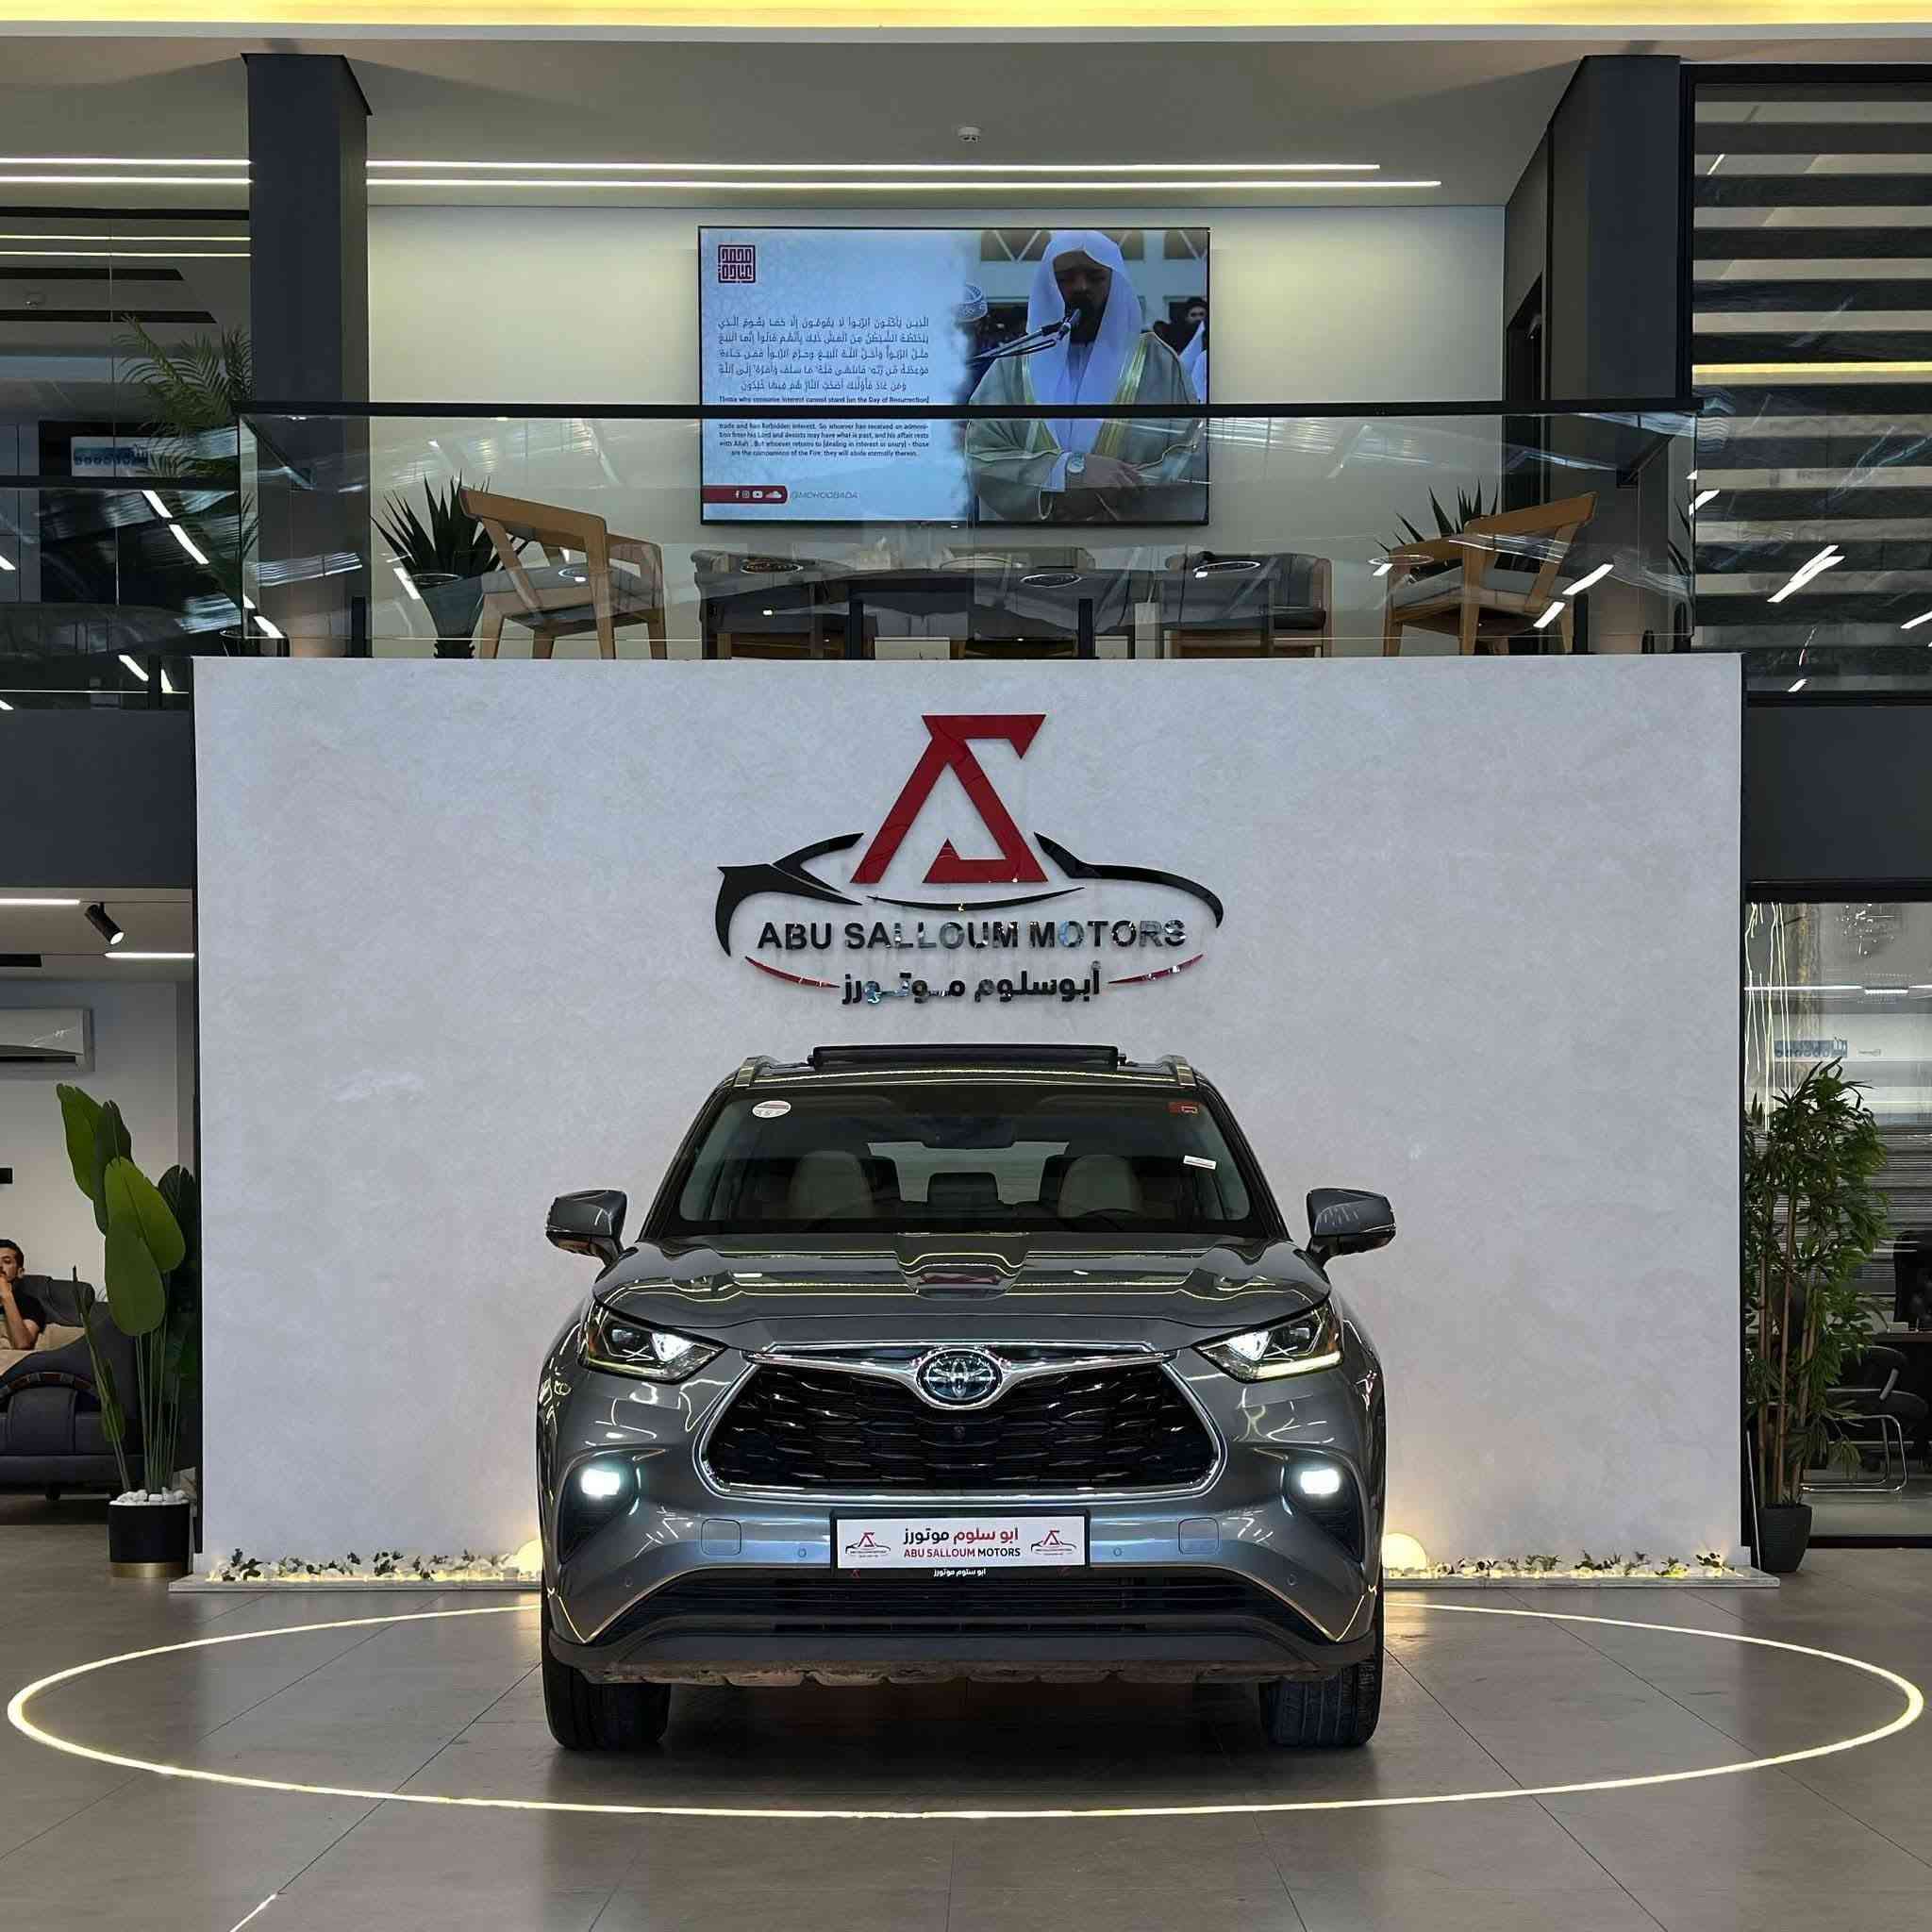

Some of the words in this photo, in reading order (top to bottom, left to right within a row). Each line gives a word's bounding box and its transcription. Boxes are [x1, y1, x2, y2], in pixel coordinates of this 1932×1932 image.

[757, 921, 832, 950] ABU
[843, 921, 1019, 950] SALLOUM
[1029, 921, 1187, 948] MOTORS
[903, 1528, 950, 1545] موتورز
[953, 1527, 995, 1545] سلوم
[904, 1548, 924, 1558] ABU
[926, 1548, 975, 1557] SALLOUM
[977, 1547, 1021, 1557] MOTORS
